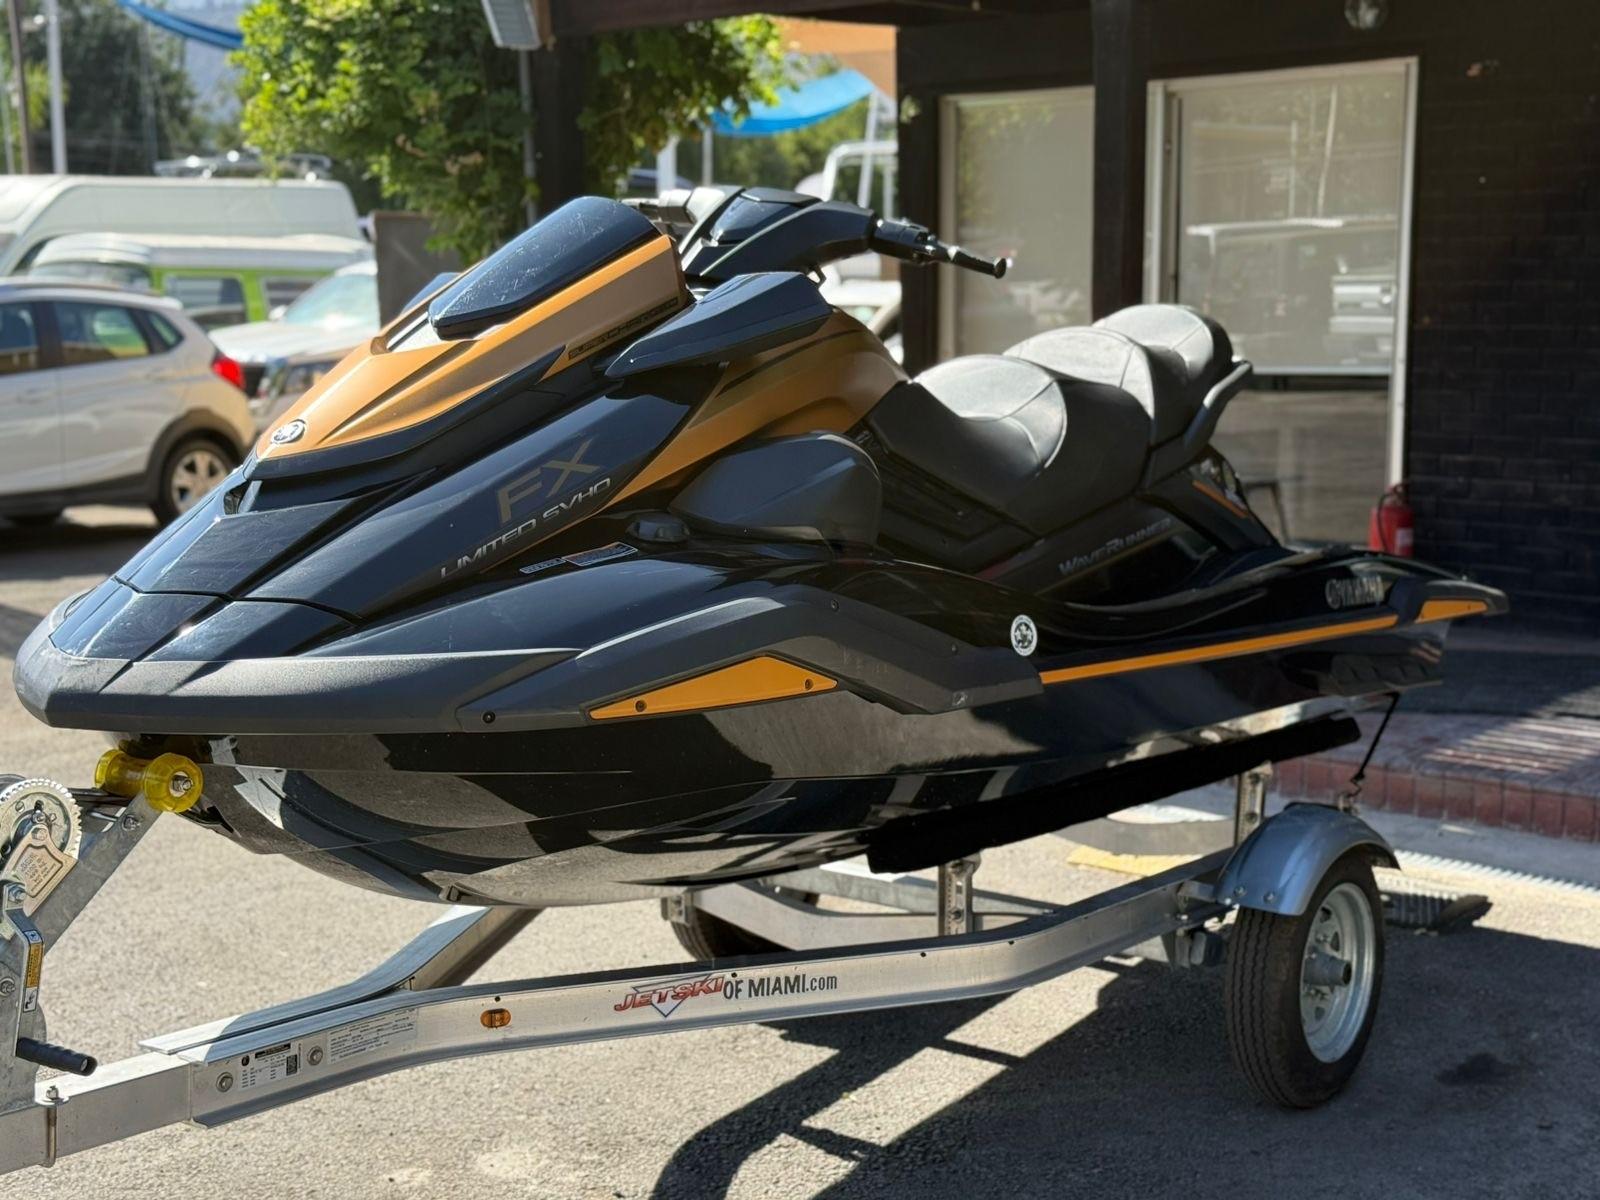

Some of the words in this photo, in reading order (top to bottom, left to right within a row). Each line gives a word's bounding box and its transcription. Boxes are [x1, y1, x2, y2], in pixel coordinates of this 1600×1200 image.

[497, 437, 604, 523] FX
[440, 518, 537, 579] LIMITED
[542, 477, 611, 519] SVHO
[613, 974, 725, 1011] JETSKI
[723, 979, 743, 1000] OF
[749, 973, 838, 999] MIAMI.com
